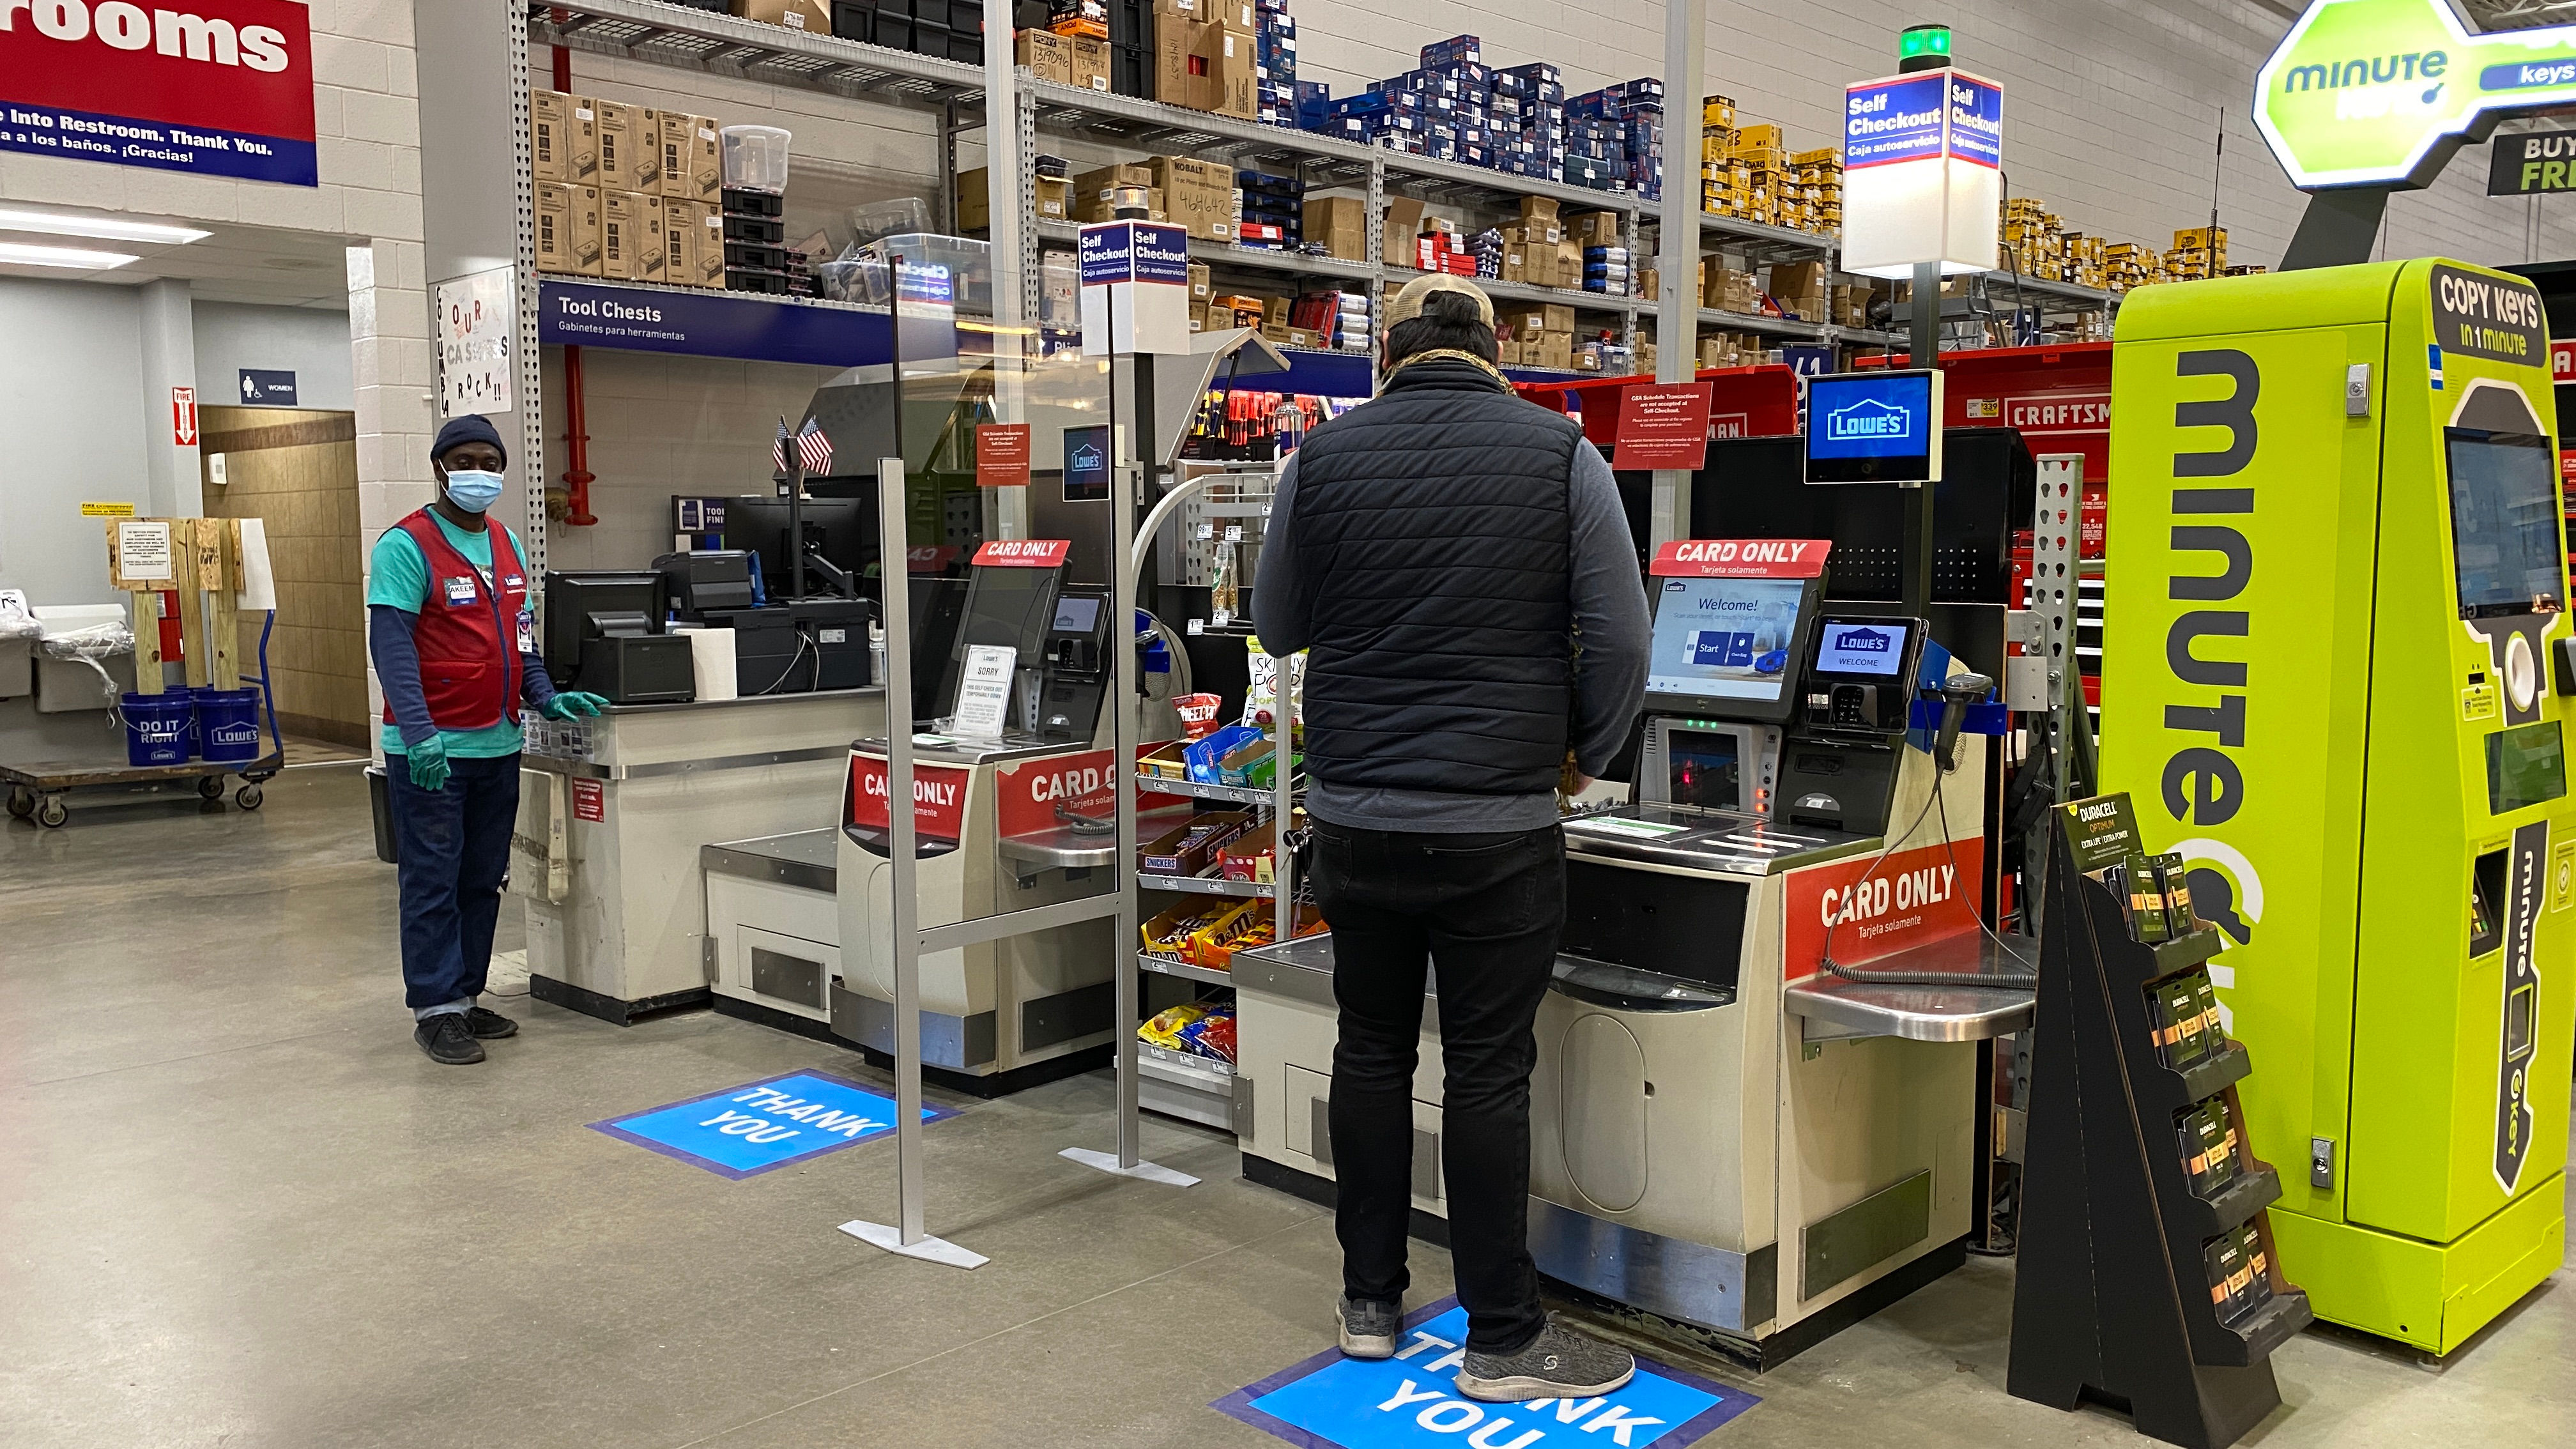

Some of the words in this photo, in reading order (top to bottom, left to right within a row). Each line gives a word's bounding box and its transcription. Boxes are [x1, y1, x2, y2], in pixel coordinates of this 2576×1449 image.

[1034, 34, 1055, 47] PONY
[1077, 42, 1097, 54] PONY
[2284, 50, 2448, 93] minute
[2520, 65, 2576, 84] keys
[1848, 93, 1888, 116] Self
[1952, 84, 1974, 106] Self
[1848, 107, 1942, 135] Checkout
[1951, 106, 1999, 136] Checkout
[11, 109, 53, 128] Into
[59, 116, 164, 142] Restroom.
[169, 130, 229, 150] Thank
[234, 139, 272, 155] You.
[17, 134, 27, 143] a
[32, 132, 57, 146] los
[63, 135, 116, 154] baños.
[122, 146, 194, 162] ¡Gracias!
[1848, 144, 1872, 157] Caja
[1873, 134, 1940, 153] autoservicio
[1174, 162, 1203, 174] KOBALT
[1180, 191, 1228, 217] 464642
[1082, 234, 1101, 249] Self
[1135, 231, 1157, 245] Self
[1082, 247, 1129, 263] Checkout
[1136, 246, 1186, 263] Checkout
[1083, 269, 1095, 277] Caja
[1096, 265, 1130, 276] autoservicio
[1137, 264, 1150, 274] Caja
[1151, 268, 1186, 277] autoservicio
[2441, 274, 2489, 319] COPY
[452, 300, 481, 334] OUR
[558, 296, 597, 316] Tool
[602, 300, 662, 322] Chests
[558, 321, 603, 334] Gabinetes
[605, 326, 625, 337] para
[627, 326, 686, 341] herramientas
[2460, 323, 2473, 347] in
[2474, 326, 2481, 348] 1
[2483, 328, 2527, 356] minute
[1836, 413, 1901, 435] LOWE'S
[1075, 454, 1100, 468] LOWE'S
[987, 542, 1022, 556] CARD
[1022, 542, 1058, 556] ONLY
[1675, 542, 1738, 562] CARD
[1741, 542, 1808, 563] ONLY
[1701, 565, 1726, 575] Tarjeta
[1727, 566, 1768, 575] solamente
[2162, 348, 2262, 826] minute
[1699, 598, 1758, 611] Welcome!
[1699, 643, 1719, 653] Start
[1841, 636, 1885, 650] LOWE'S
[977, 666, 999, 676] SORRY
[1255, 657, 1305, 673] SKINY
[1839, 658, 1878, 667] WELCOME
[140, 721, 161, 732] DO
[166, 720, 179, 732] IT
[217, 729, 257, 742] LOWE'S
[864, 773, 889, 797] CA
[913, 779, 956, 806] ONLY
[1031, 767, 1098, 802] CARD
[914, 807, 937, 817] amente
[1070, 799, 1094, 809] Tarjeta
[1095, 795, 1115, 805] solam
[2080, 801, 2118, 822] DURACELL
[2089, 819, 2115, 833] OPTIMUM
[1146, 857, 1176, 869] SNICKERS
[1821, 877, 1890, 928] CARD
[1896, 863, 1956, 911] ONLY
[2517, 850, 2533, 977] minute
[1859, 924, 1883, 939] Tarjeta
[1885, 914, 1921, 933] solamente
[732, 1086, 889, 1137] THANK
[698, 1109, 802, 1144] YOU
[1393, 1330, 1667, 1448] THNK
[1376, 1379, 1547, 1449] YOU
